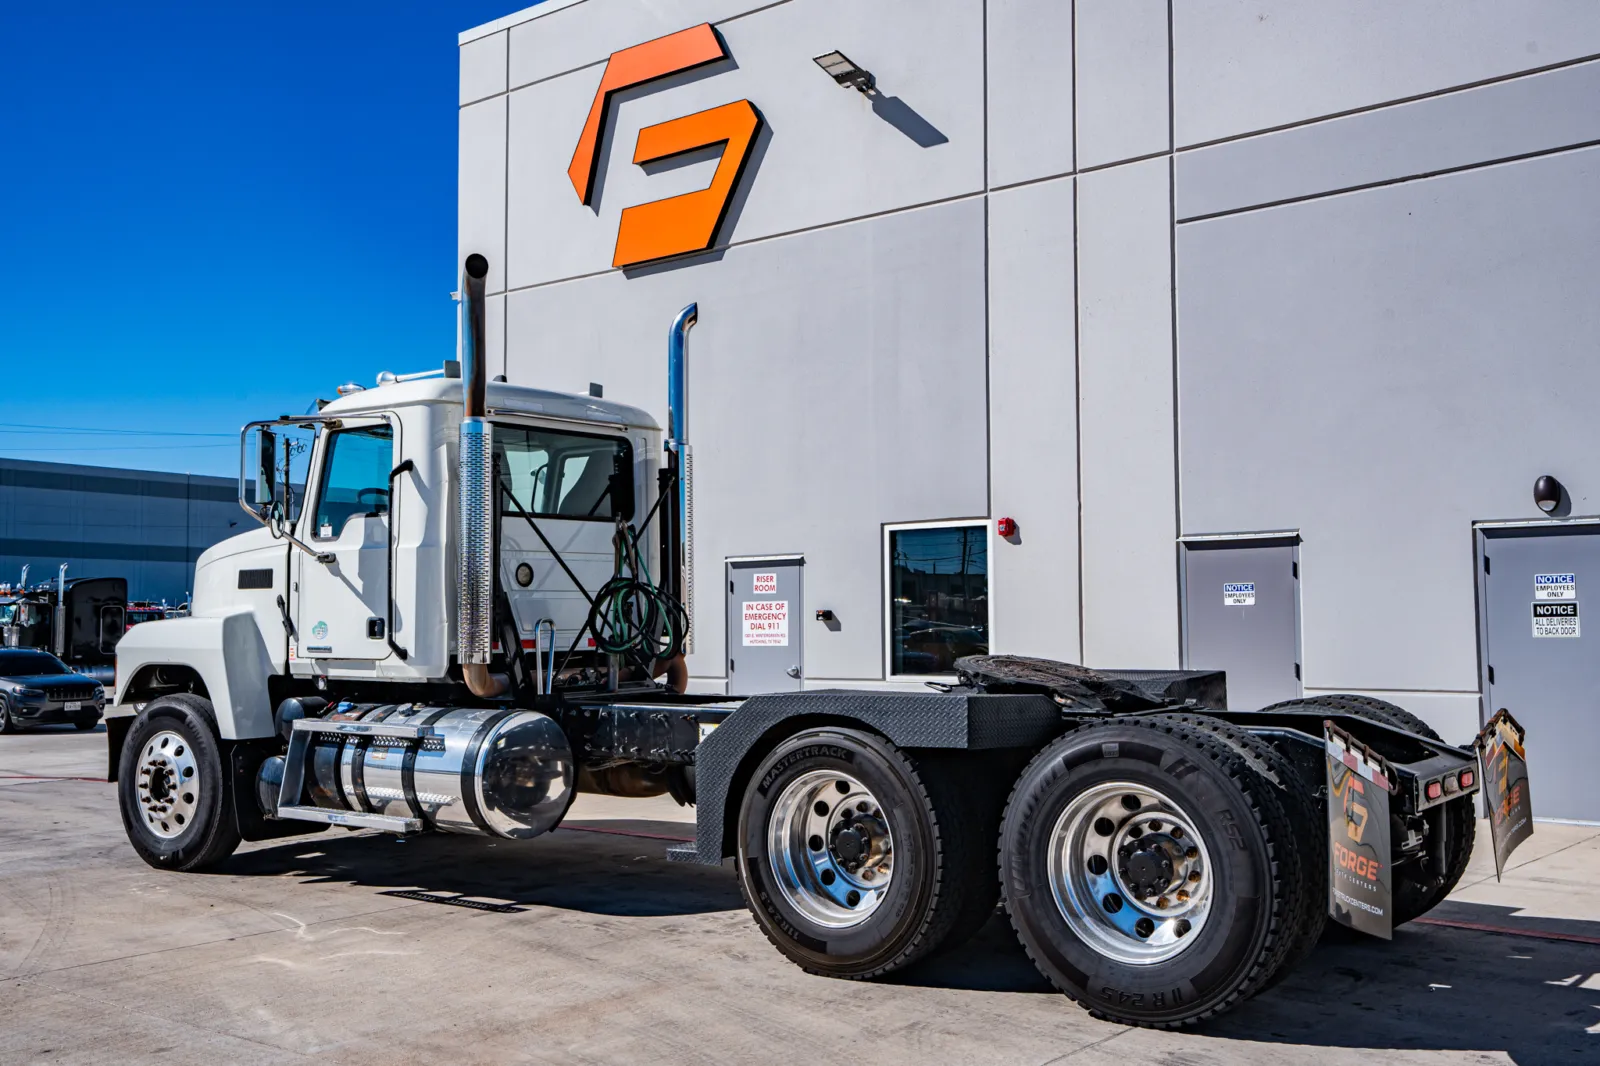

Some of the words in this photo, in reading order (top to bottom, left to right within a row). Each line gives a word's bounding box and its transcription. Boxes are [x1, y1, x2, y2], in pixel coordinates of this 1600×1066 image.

[1537, 606, 1574, 614] NOTICE
[1535, 618, 1545, 626] ALL
[1546, 618, 1576, 626] DELIVERIES
[1536, 627, 1543, 635] TO
[1545, 627, 1559, 635] BACK
[1561, 627, 1576, 635] DOOR
[762, 745, 849, 790] MASTERTRACK
[1333, 841, 1379, 881] FORGE
[1348, 876, 1377, 893] CENTERS
